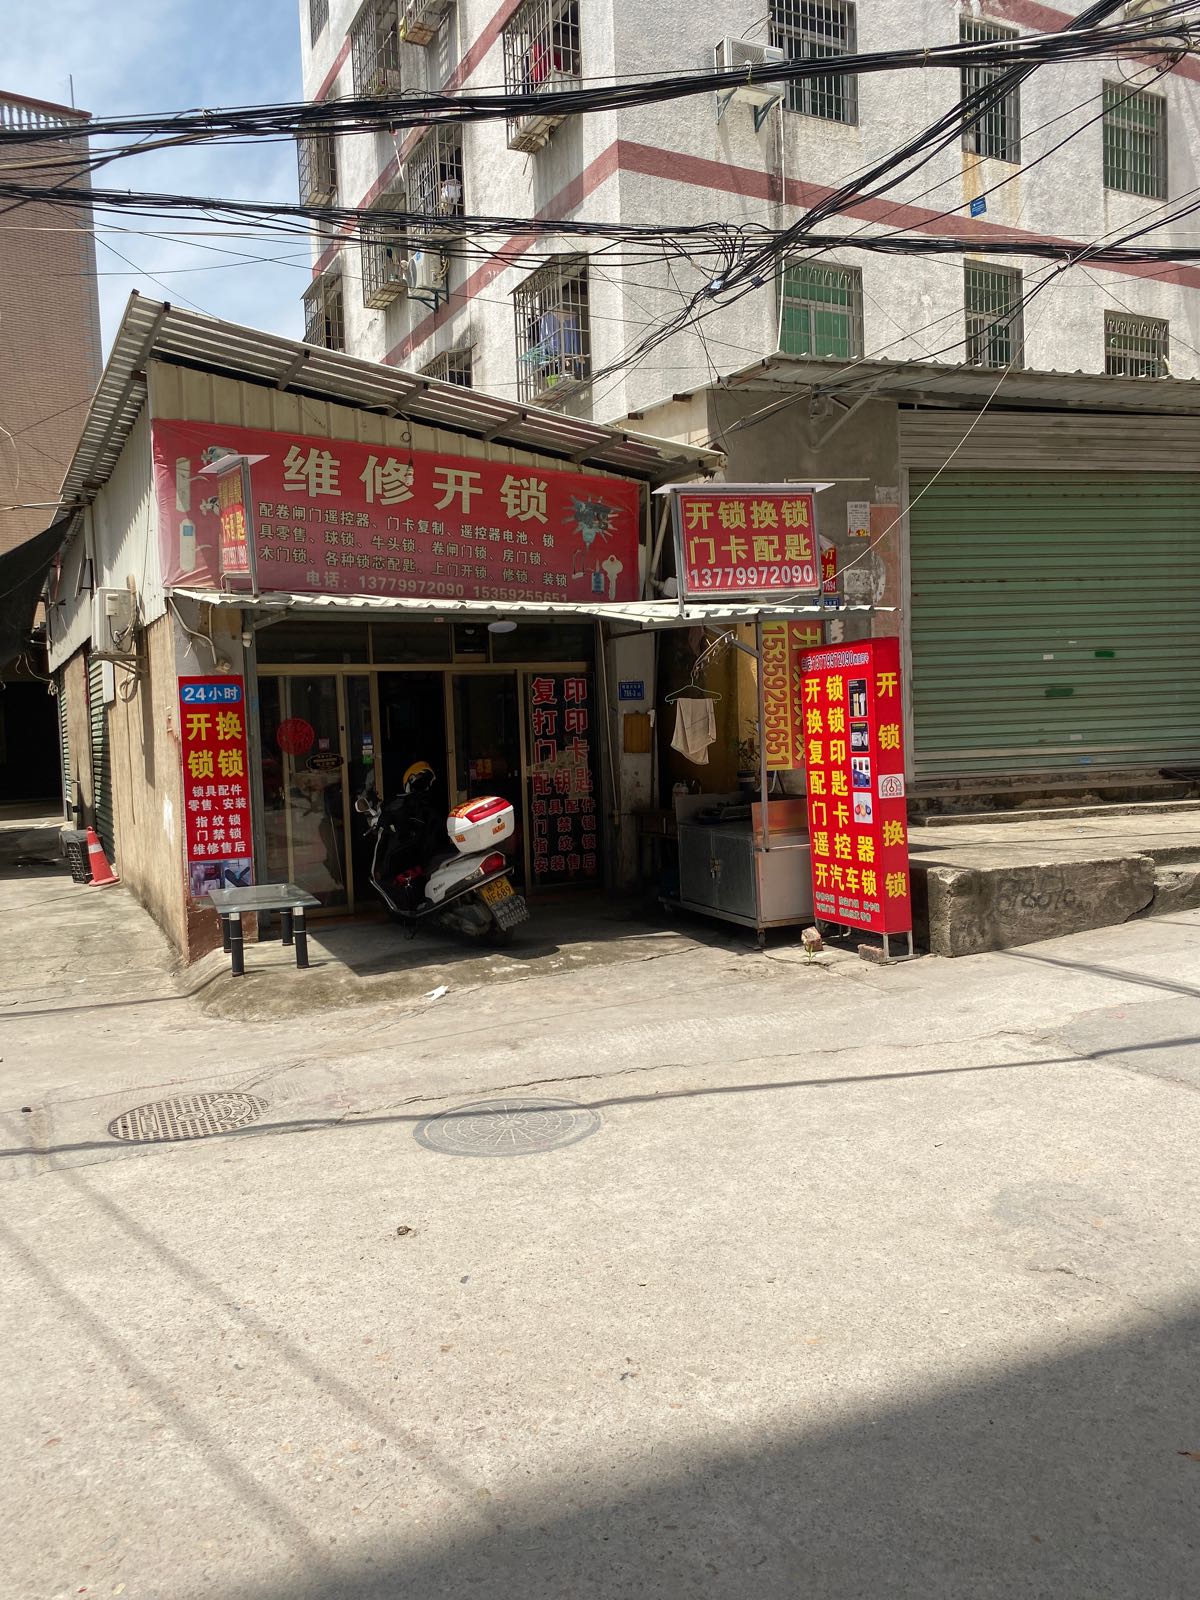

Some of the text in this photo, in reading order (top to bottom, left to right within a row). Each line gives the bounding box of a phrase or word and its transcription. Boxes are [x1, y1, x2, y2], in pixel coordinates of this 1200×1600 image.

[282, 445, 549, 524] 维修开锁
[685, 500, 809, 530] 开锁换锁
[690, 534, 812, 565] 门卡配匙
[690, 565, 813, 588] 13779972090
[473, 586, 567, 601] 15359255651
[184, 686, 238, 701] 24小时
[532, 677, 587, 705] 复印
[762, 625, 790, 766] 15359255651
[804, 674, 844, 704] 开锁
[532, 708, 588, 735] 打印
[806, 706, 845, 734] 换锁
[534, 736, 590, 764] 门卡
[808, 739, 846, 765] 复印
[192, 784, 242, 798] 锁具配件
[532, 768, 593, 796] 配钥匙
[809, 770, 849, 797] 配匙
[188, 798, 247, 811] 零售、安装
[532, 798, 596, 816] 锁具配件
[811, 800, 850, 829] 门卡
[195, 814, 241, 828] 指纹锁
[197, 828, 242, 841] 门禁锁
[193, 841, 246, 856] 维修售后
[813, 831, 875, 863] 遥控器
[534, 854, 597, 873] 安装售后
[815, 863, 877, 898] 开汽车锁
